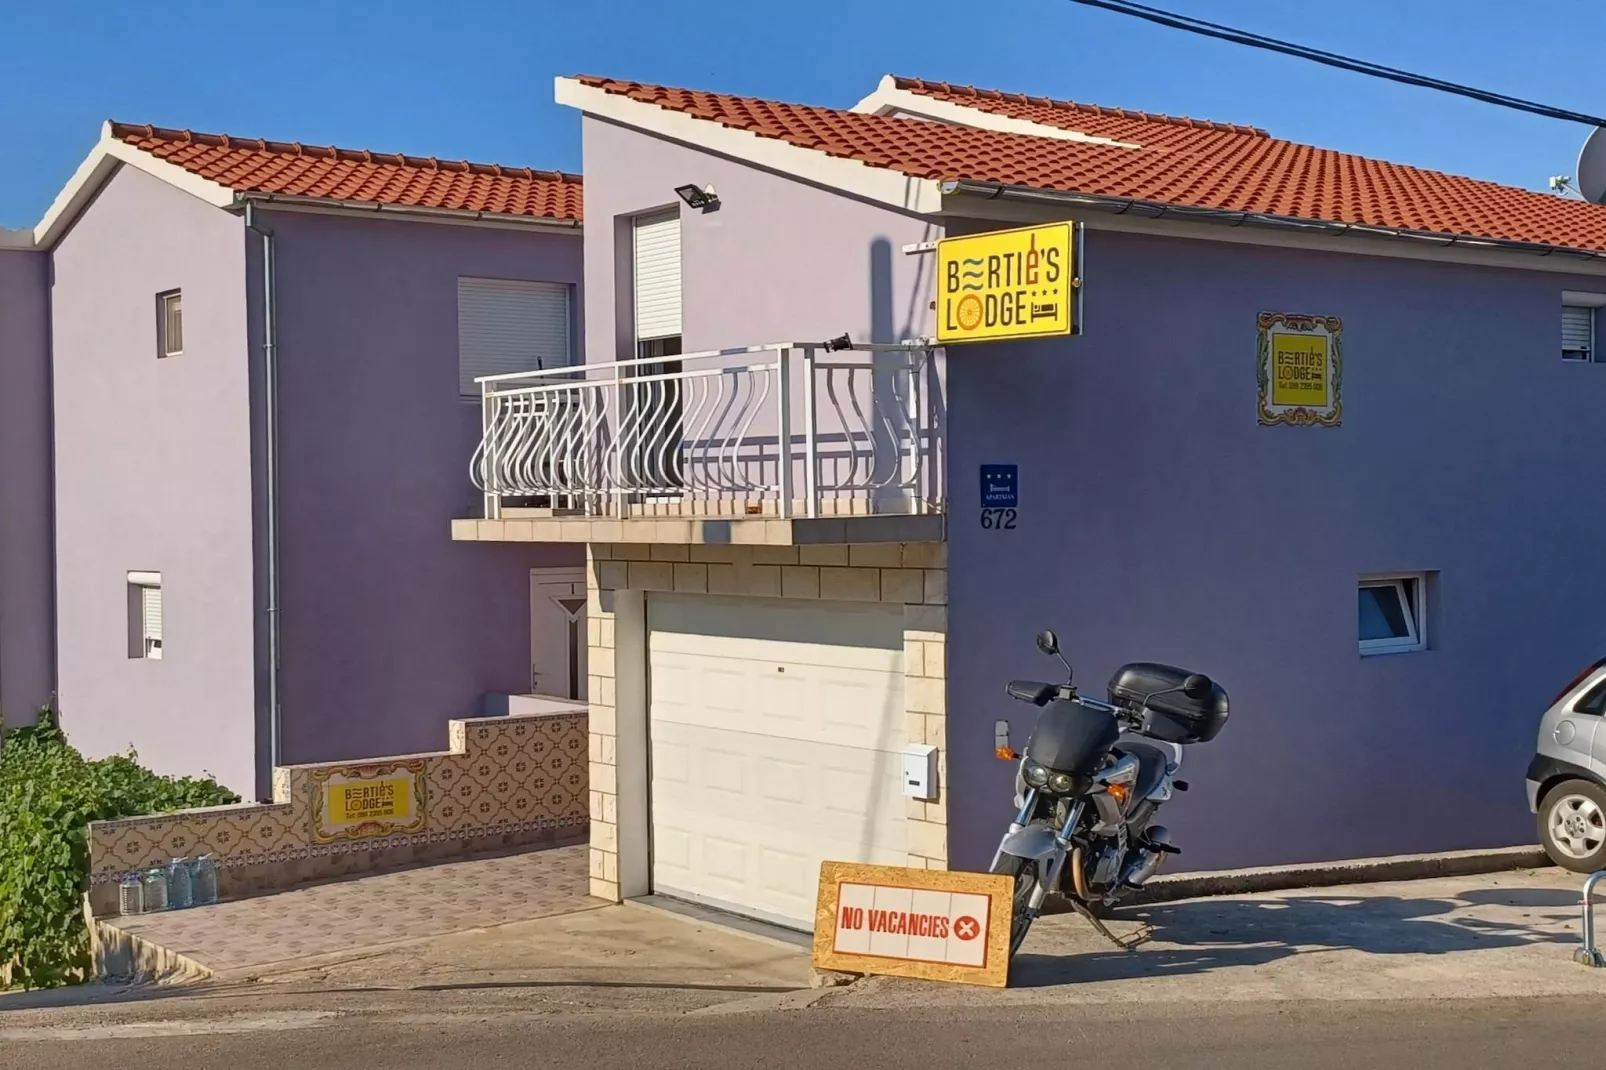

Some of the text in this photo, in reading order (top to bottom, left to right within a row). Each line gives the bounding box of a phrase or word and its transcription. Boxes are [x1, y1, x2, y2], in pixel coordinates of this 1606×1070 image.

[946, 291, 1027, 331] LODGE
[1278, 365, 1311, 380] LODGE
[980, 508, 1017, 530] 672
[345, 797, 381, 811] LODGE
[841, 906, 950, 939] NO VACANCIES
